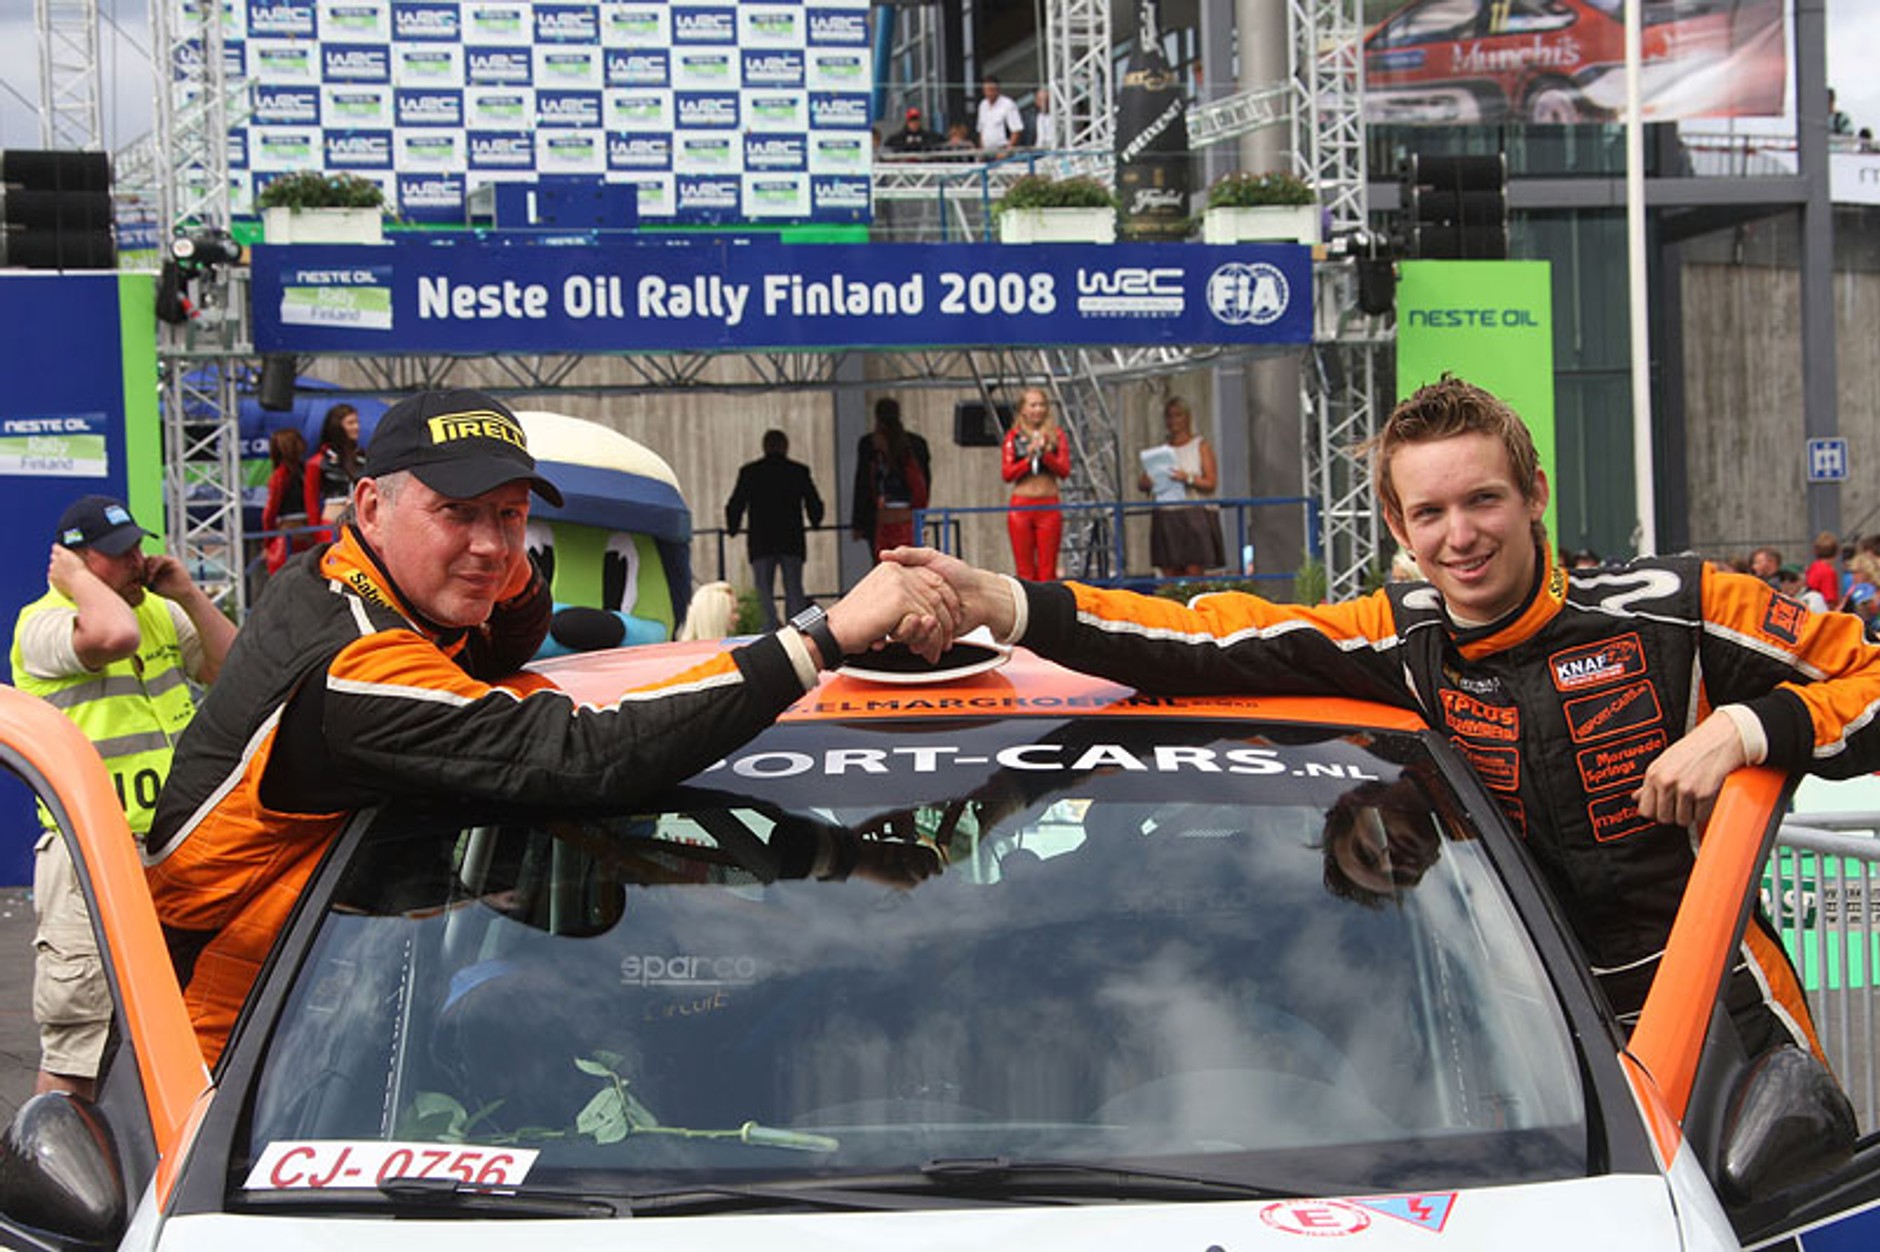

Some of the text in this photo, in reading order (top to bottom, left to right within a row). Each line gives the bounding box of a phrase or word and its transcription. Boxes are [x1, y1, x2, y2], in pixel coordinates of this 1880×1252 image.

[252, 6, 315, 21] WRC
[397, 10, 459, 25] WRC
[539, 12, 595, 27] WRC
[677, 14, 733, 29] WRC
[811, 16, 866, 31] WRC
[326, 52, 387, 67] WRC
[470, 54, 529, 69] WRC
[610, 56, 666, 71] WRC
[746, 57, 801, 72] WRC
[255, 94, 314, 109] WRC
[400, 96, 459, 111] WRC
[541, 98, 597, 113] WRC
[680, 99, 735, 114] WRC
[815, 100, 867, 115] WRC
[329, 138, 388, 153] WRC
[473, 139, 531, 154] WRC
[610, 140, 667, 155] WRC
[747, 141, 802, 156] WRC
[403, 181, 462, 196] WRC
[680, 182, 737, 197] WRC
[816, 183, 869, 198] WRC
[296, 270, 352, 283] NESTE
[1078, 268, 1185, 295] WRC
[418, 271, 1057, 325] Neste Oil Rally Finland 2008
[1211, 274, 1282, 312] FIA
[1409, 309, 1538, 327] NESTE OIL
[4, 418, 63, 434] NESTE
[620, 955, 756, 987] sparco
[270, 1146, 361, 1188] CJ-
[1291, 1209, 1342, 1228] E
